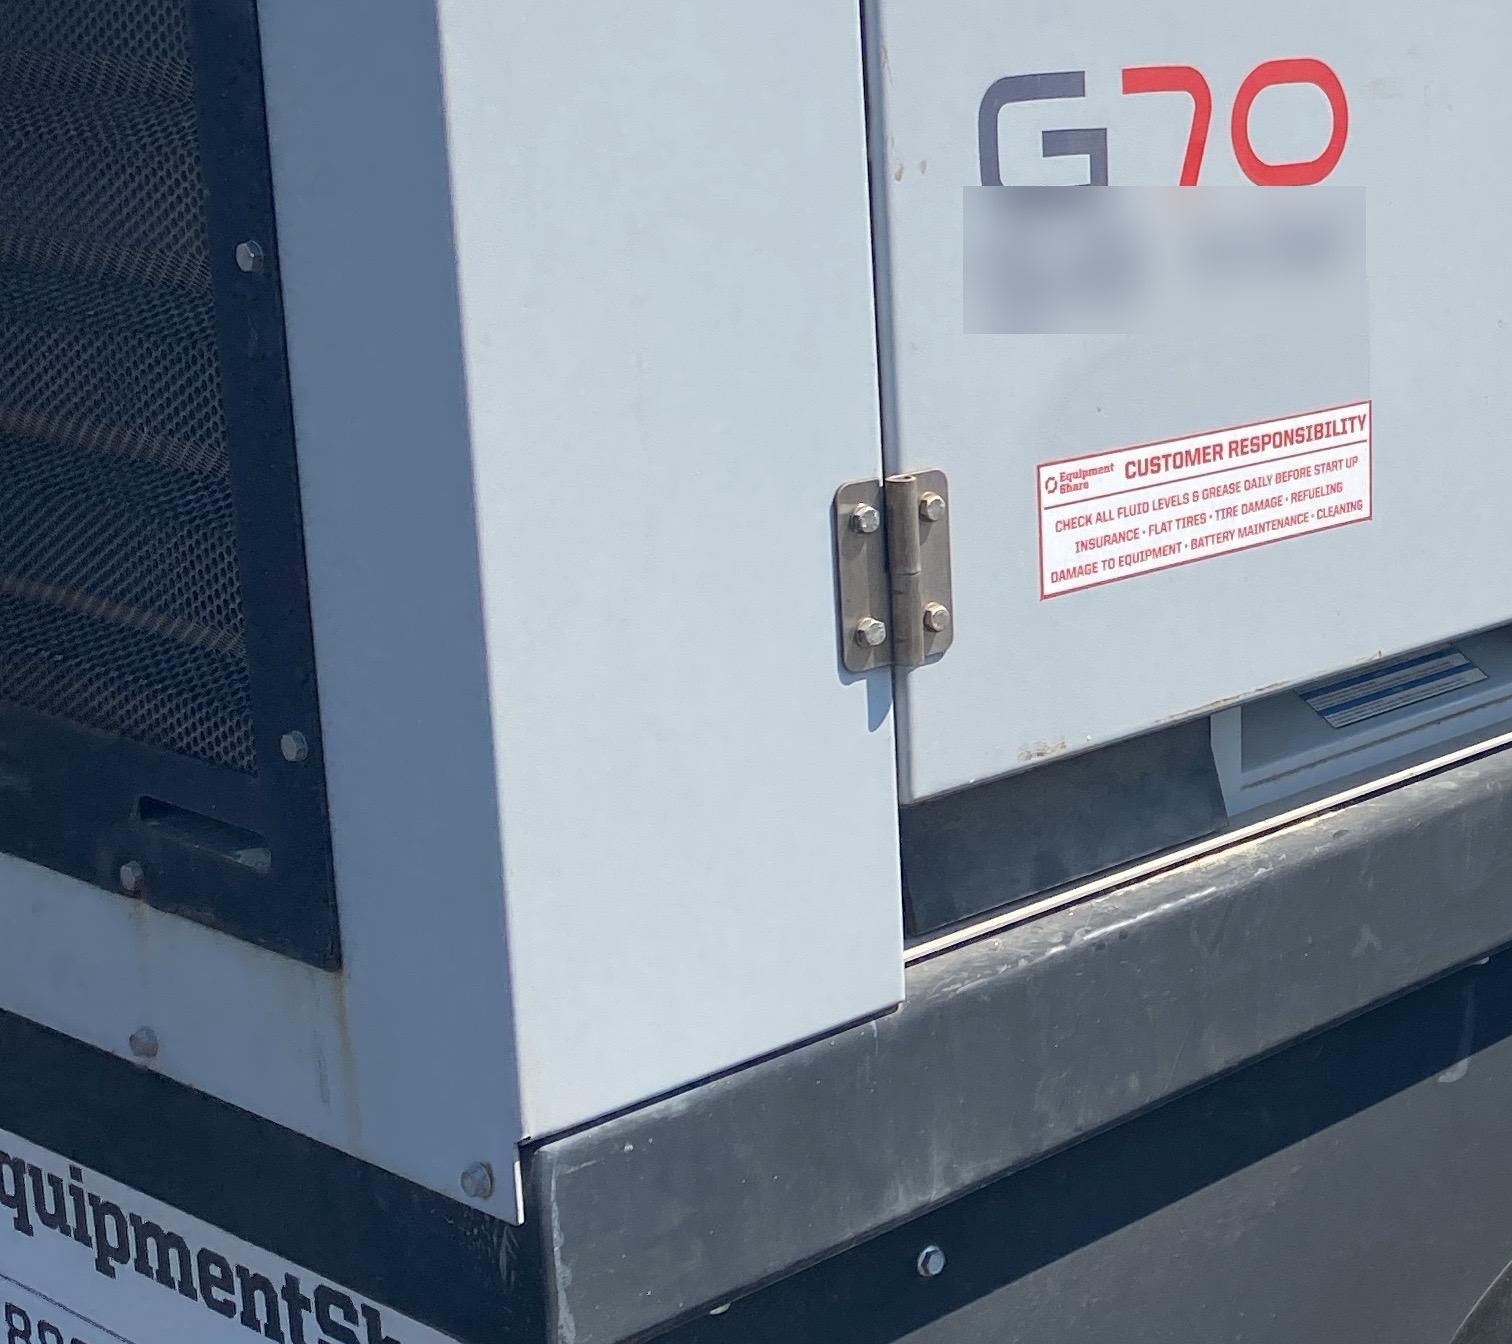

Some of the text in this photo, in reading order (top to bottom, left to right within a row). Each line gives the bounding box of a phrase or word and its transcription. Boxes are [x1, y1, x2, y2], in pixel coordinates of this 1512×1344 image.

[978, 57, 1349, 186] G70
[1059, 462, 1115, 483] Equipment
[1124, 414, 1366, 479] CUSTOMER RESPONSIBILITY
[1055, 456, 1358, 532] CHECK ALL FLUID LEVELS & GREASE DAILY BEFORE START UP
[1059, 481, 1089, 495] Share
[1075, 482, 1342, 552] INSURANCE FLAT TIRES TIRE DAMAGE REFUELING
[1051, 499, 1362, 582] DAMAGE TO EQUIPMENT BATTERY MAINTENANCE CLEANING
